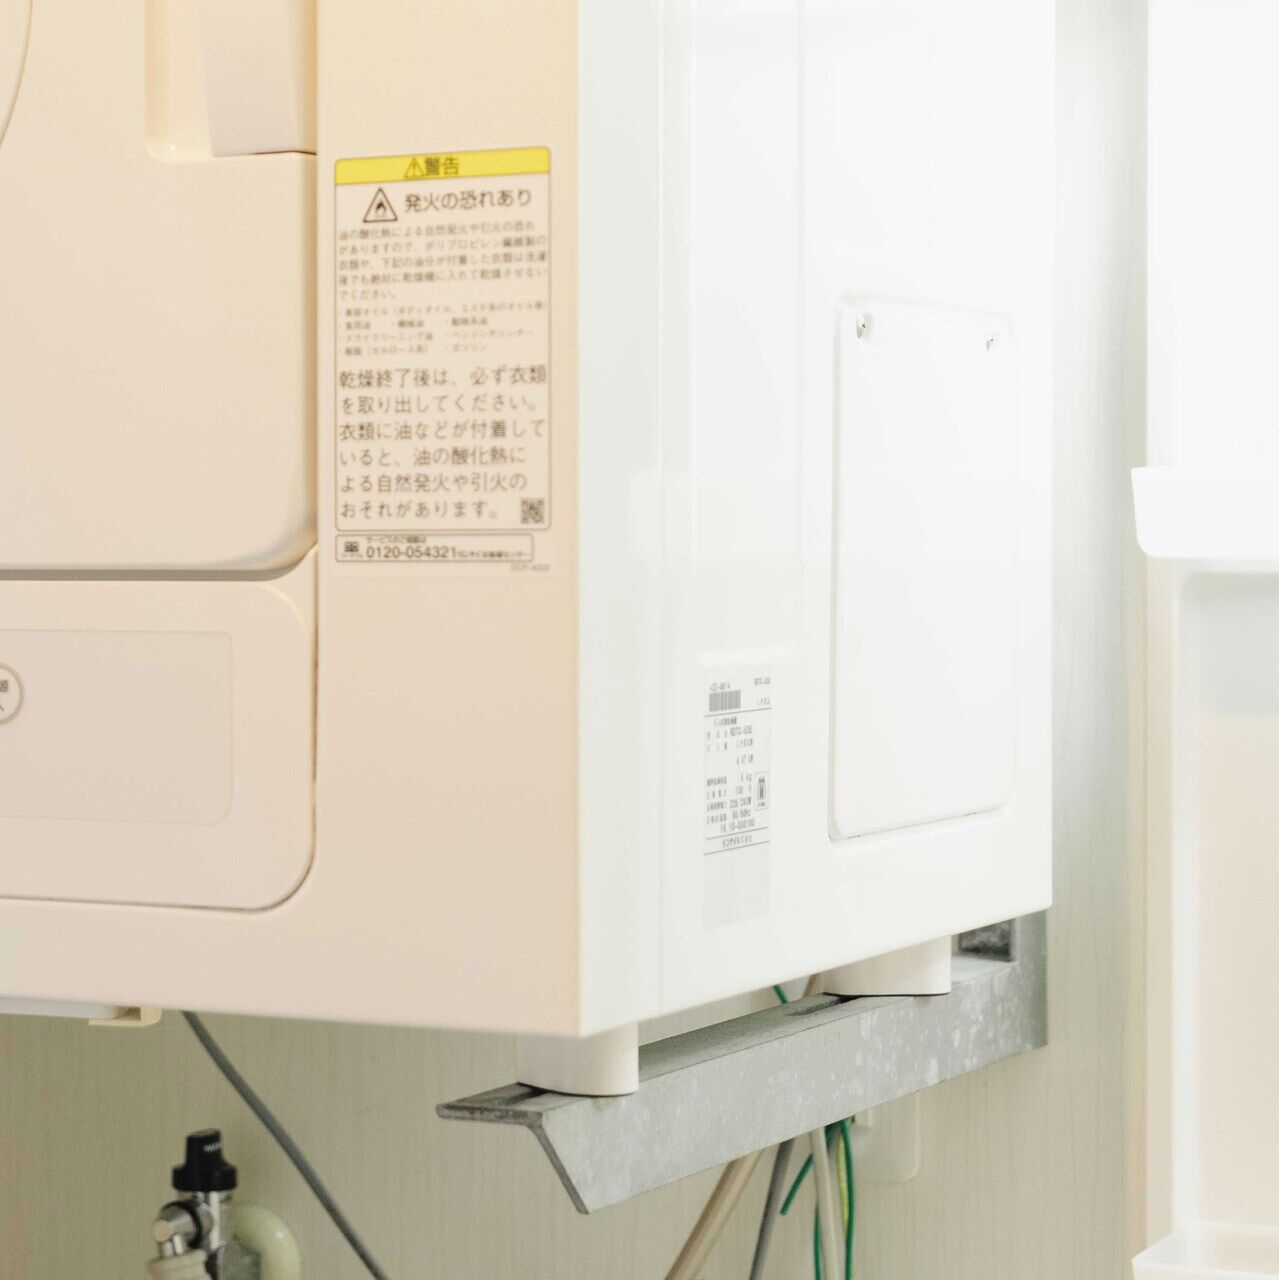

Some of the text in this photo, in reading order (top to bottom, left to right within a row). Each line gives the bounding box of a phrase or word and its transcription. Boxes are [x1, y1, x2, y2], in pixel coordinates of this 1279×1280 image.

[424, 157, 460, 177] 警告
[404, 188, 532, 214] 発火の恐れあり
[339, 365, 546, 389] 乾燥終了後は、必ず衣類
[342, 393, 534, 414] を取り出してください。
[339, 420, 544, 441] 衣類に油などが付着して
[340, 446, 524, 466] いると、油の酸化熱に
[341, 472, 527, 493] よる自然発火や引火の
[341, 500, 495, 519] おそれがあります。
[366, 545, 456, 558] 0120-054321
